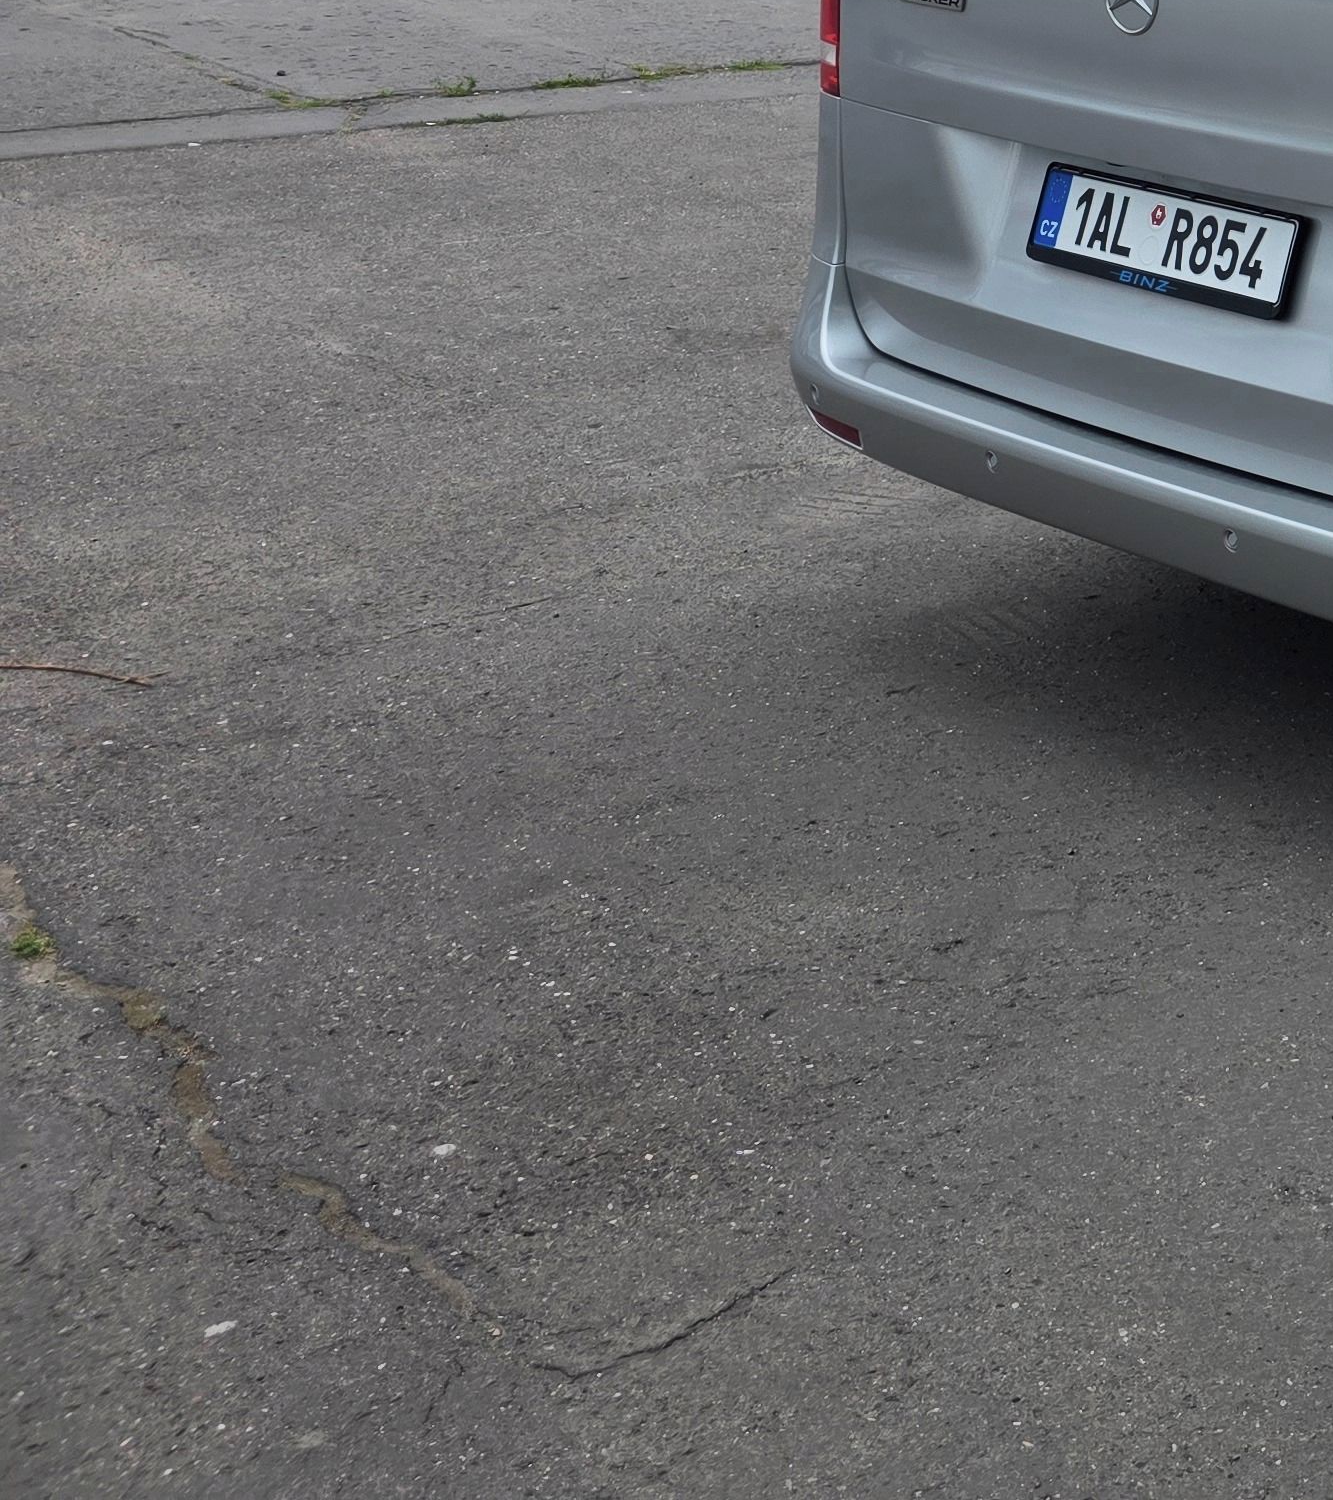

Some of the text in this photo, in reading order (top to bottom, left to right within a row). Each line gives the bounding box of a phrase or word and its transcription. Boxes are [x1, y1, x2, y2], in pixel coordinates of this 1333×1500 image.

[1039, 218, 1059, 239] CZ
[1074, 187, 1268, 289] 1AL R854
[1118, 269, 1172, 293] BINZ
